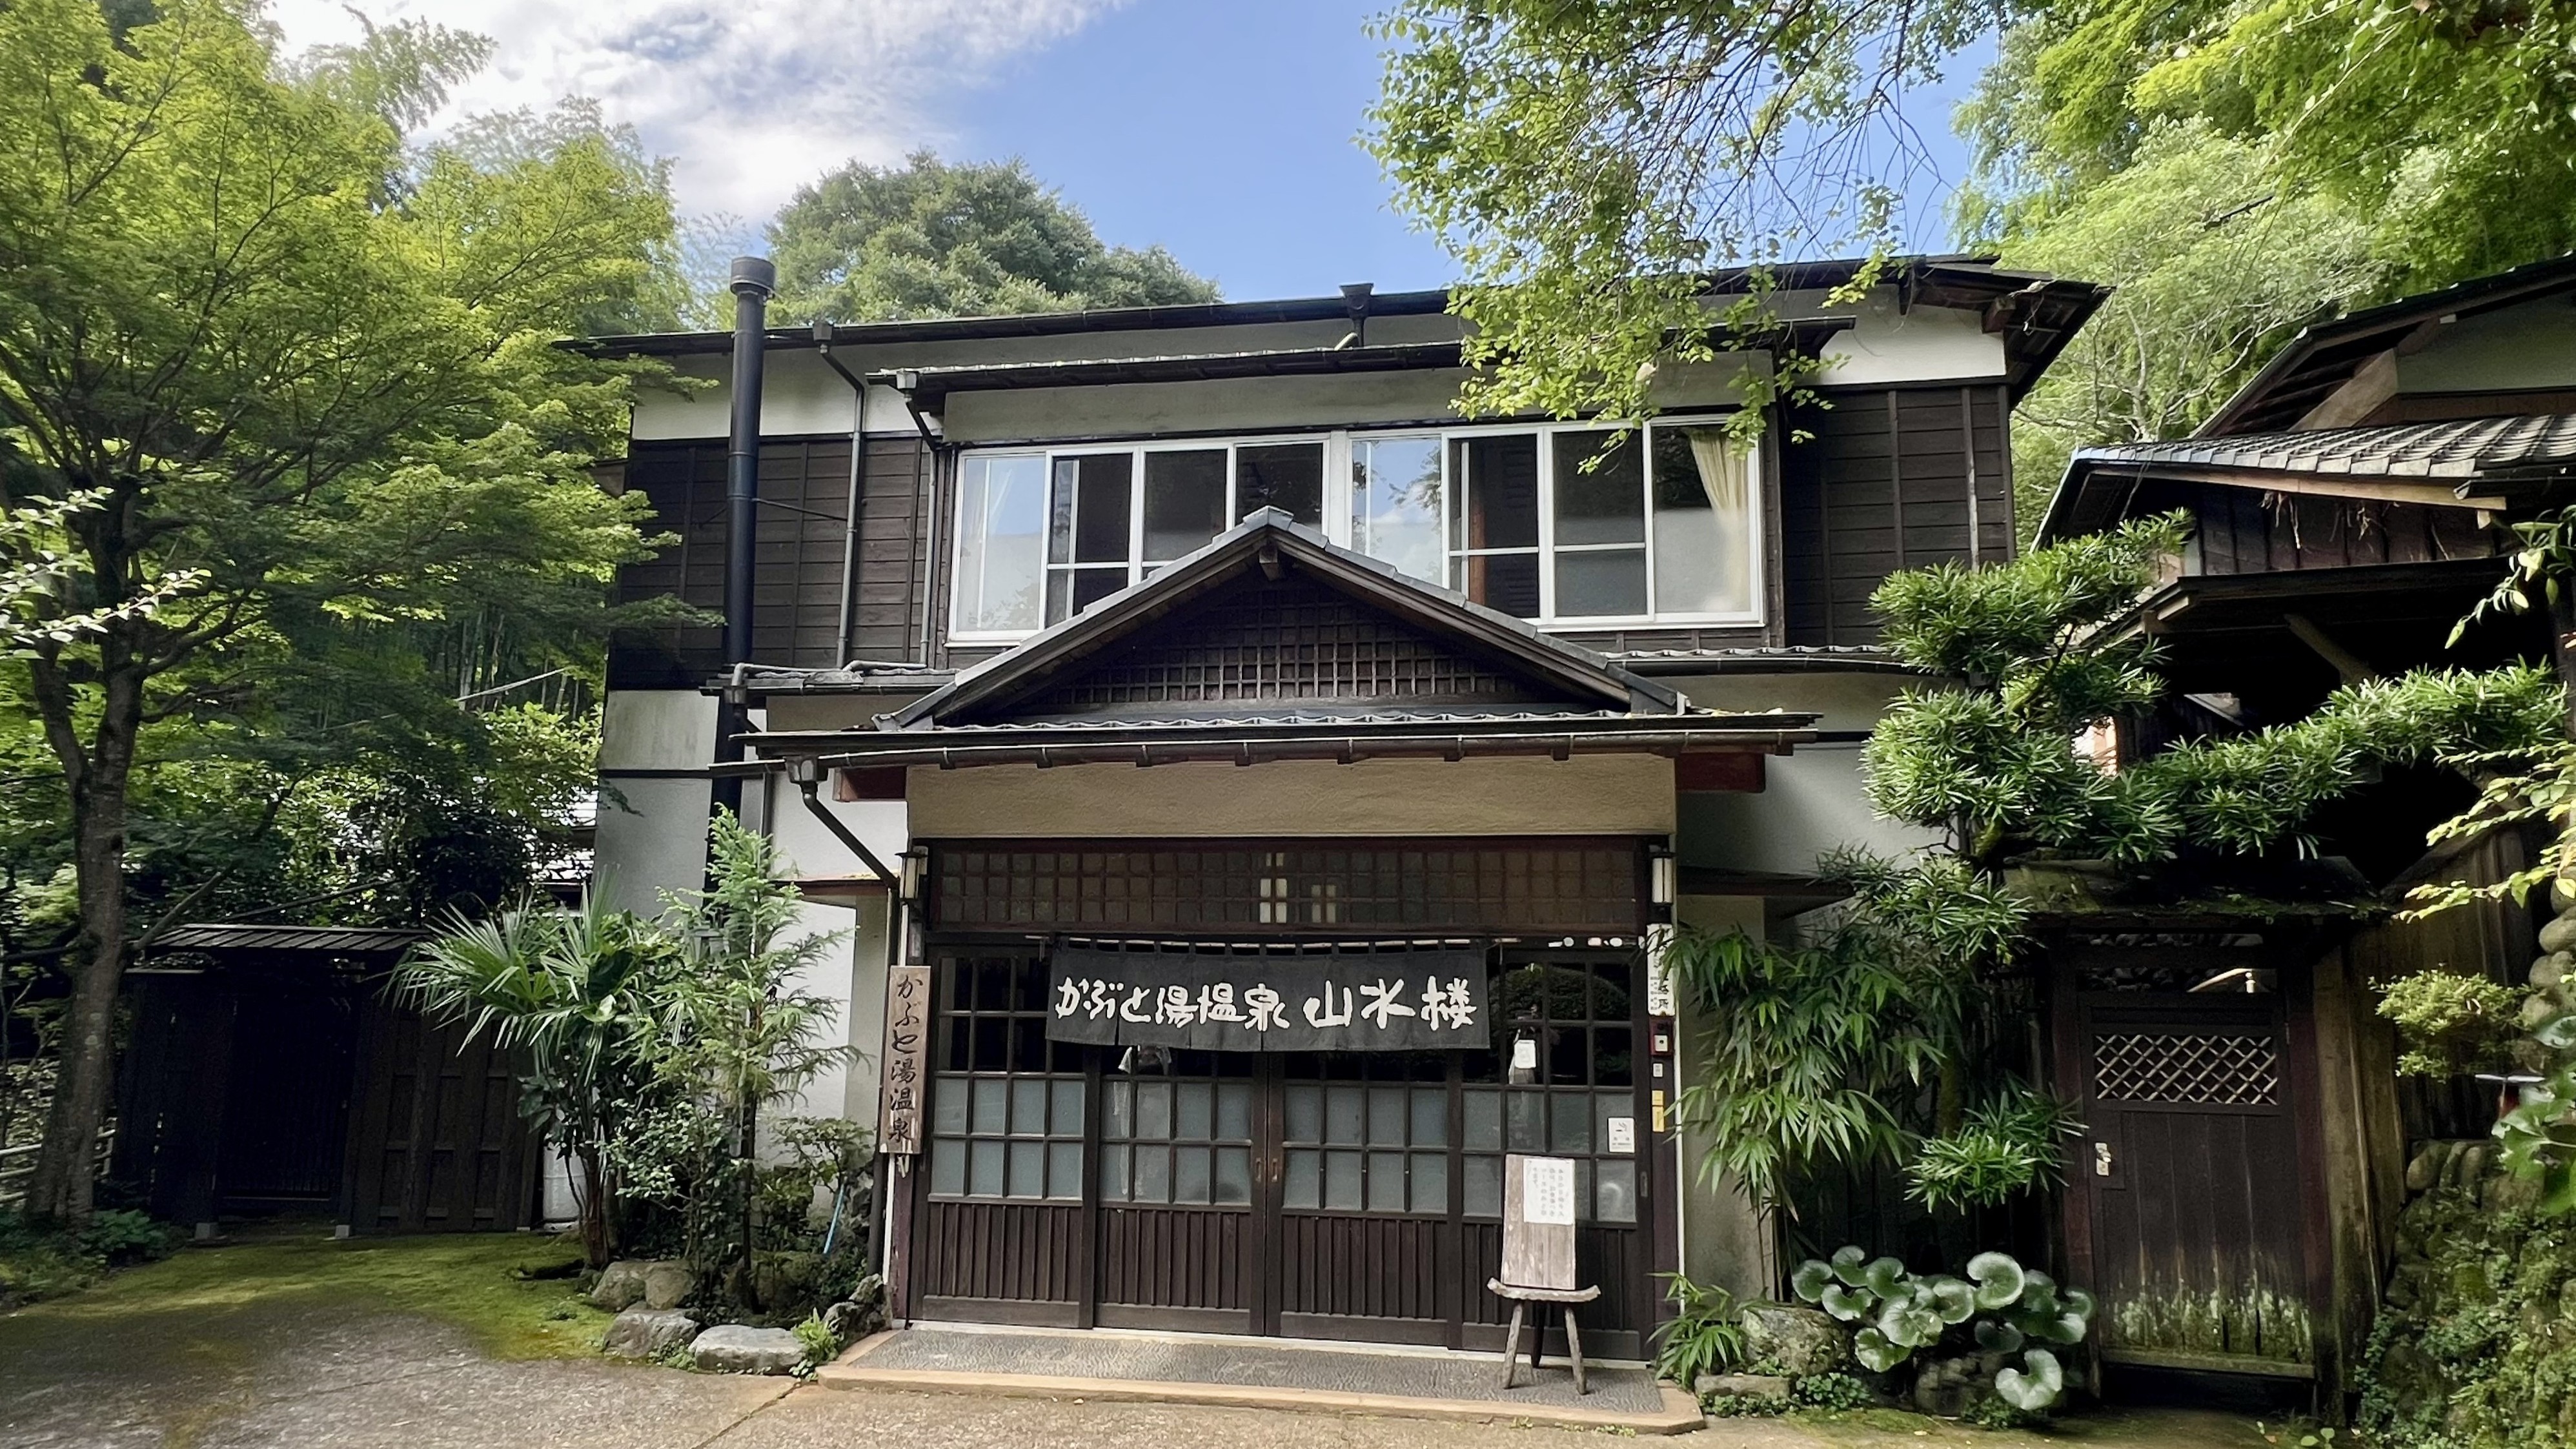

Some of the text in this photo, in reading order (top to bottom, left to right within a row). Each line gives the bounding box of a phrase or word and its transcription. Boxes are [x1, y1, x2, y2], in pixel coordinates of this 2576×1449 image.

[887, 974, 924, 1144] かぶと湯温泉
[1303, 975, 1477, 1031] 山水楼
